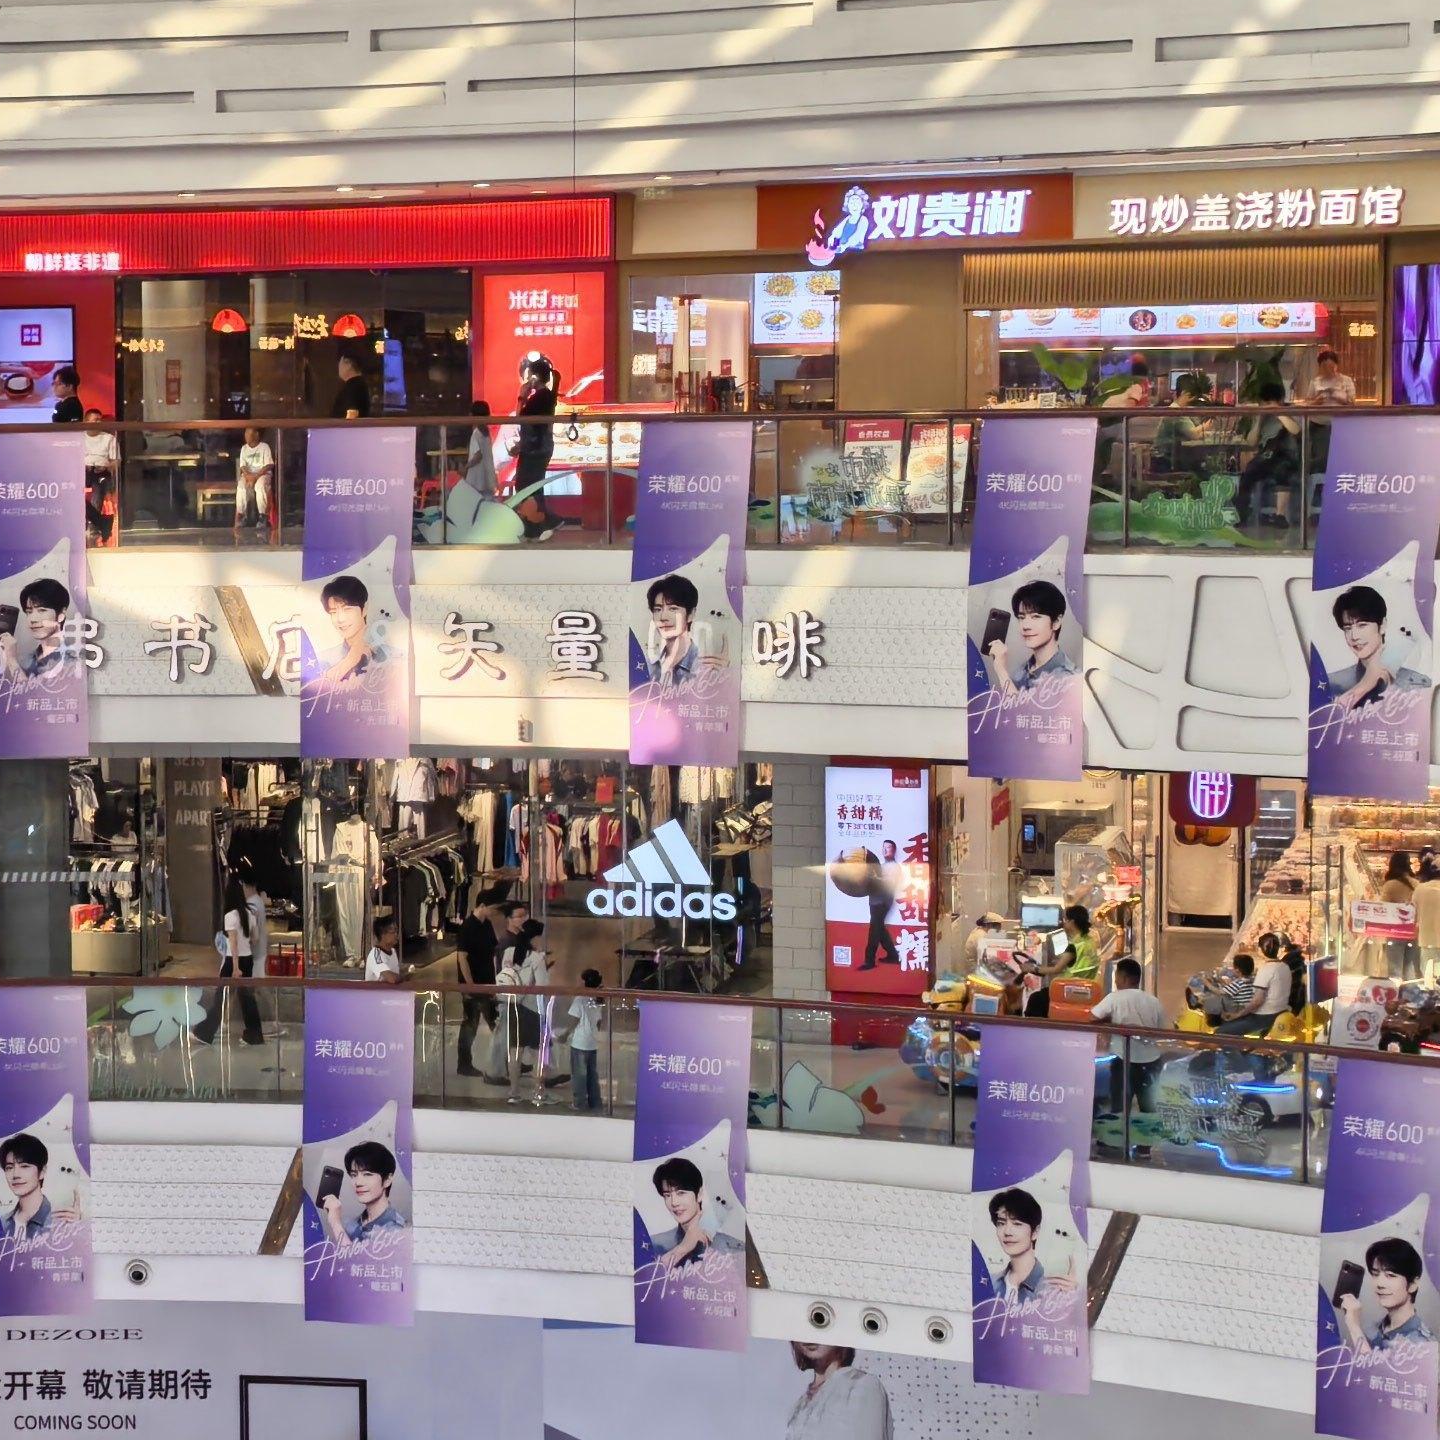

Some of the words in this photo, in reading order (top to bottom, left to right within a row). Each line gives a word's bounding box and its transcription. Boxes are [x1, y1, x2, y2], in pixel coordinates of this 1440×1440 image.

[870, 189, 1027, 240] 刘贵湘
[1109, 185, 1404, 240] 现炒盖浇粉面馆
[316, 476, 388, 498] 荣耀600
[647, 474, 722, 495] 荣耀600
[985, 472, 1063, 494] 荣耀600
[1334, 473, 1416, 496] 荣耀600
[836, 804, 883, 822] 香甜糯
[586, 881, 738, 921] adidas
[6, 1328, 144, 1341] DEZOEE
[82, 1368, 212, 1401] 敬请期待
[14, 1414, 83, 1431] COMING
[87, 1414, 137, 1431] SOON
